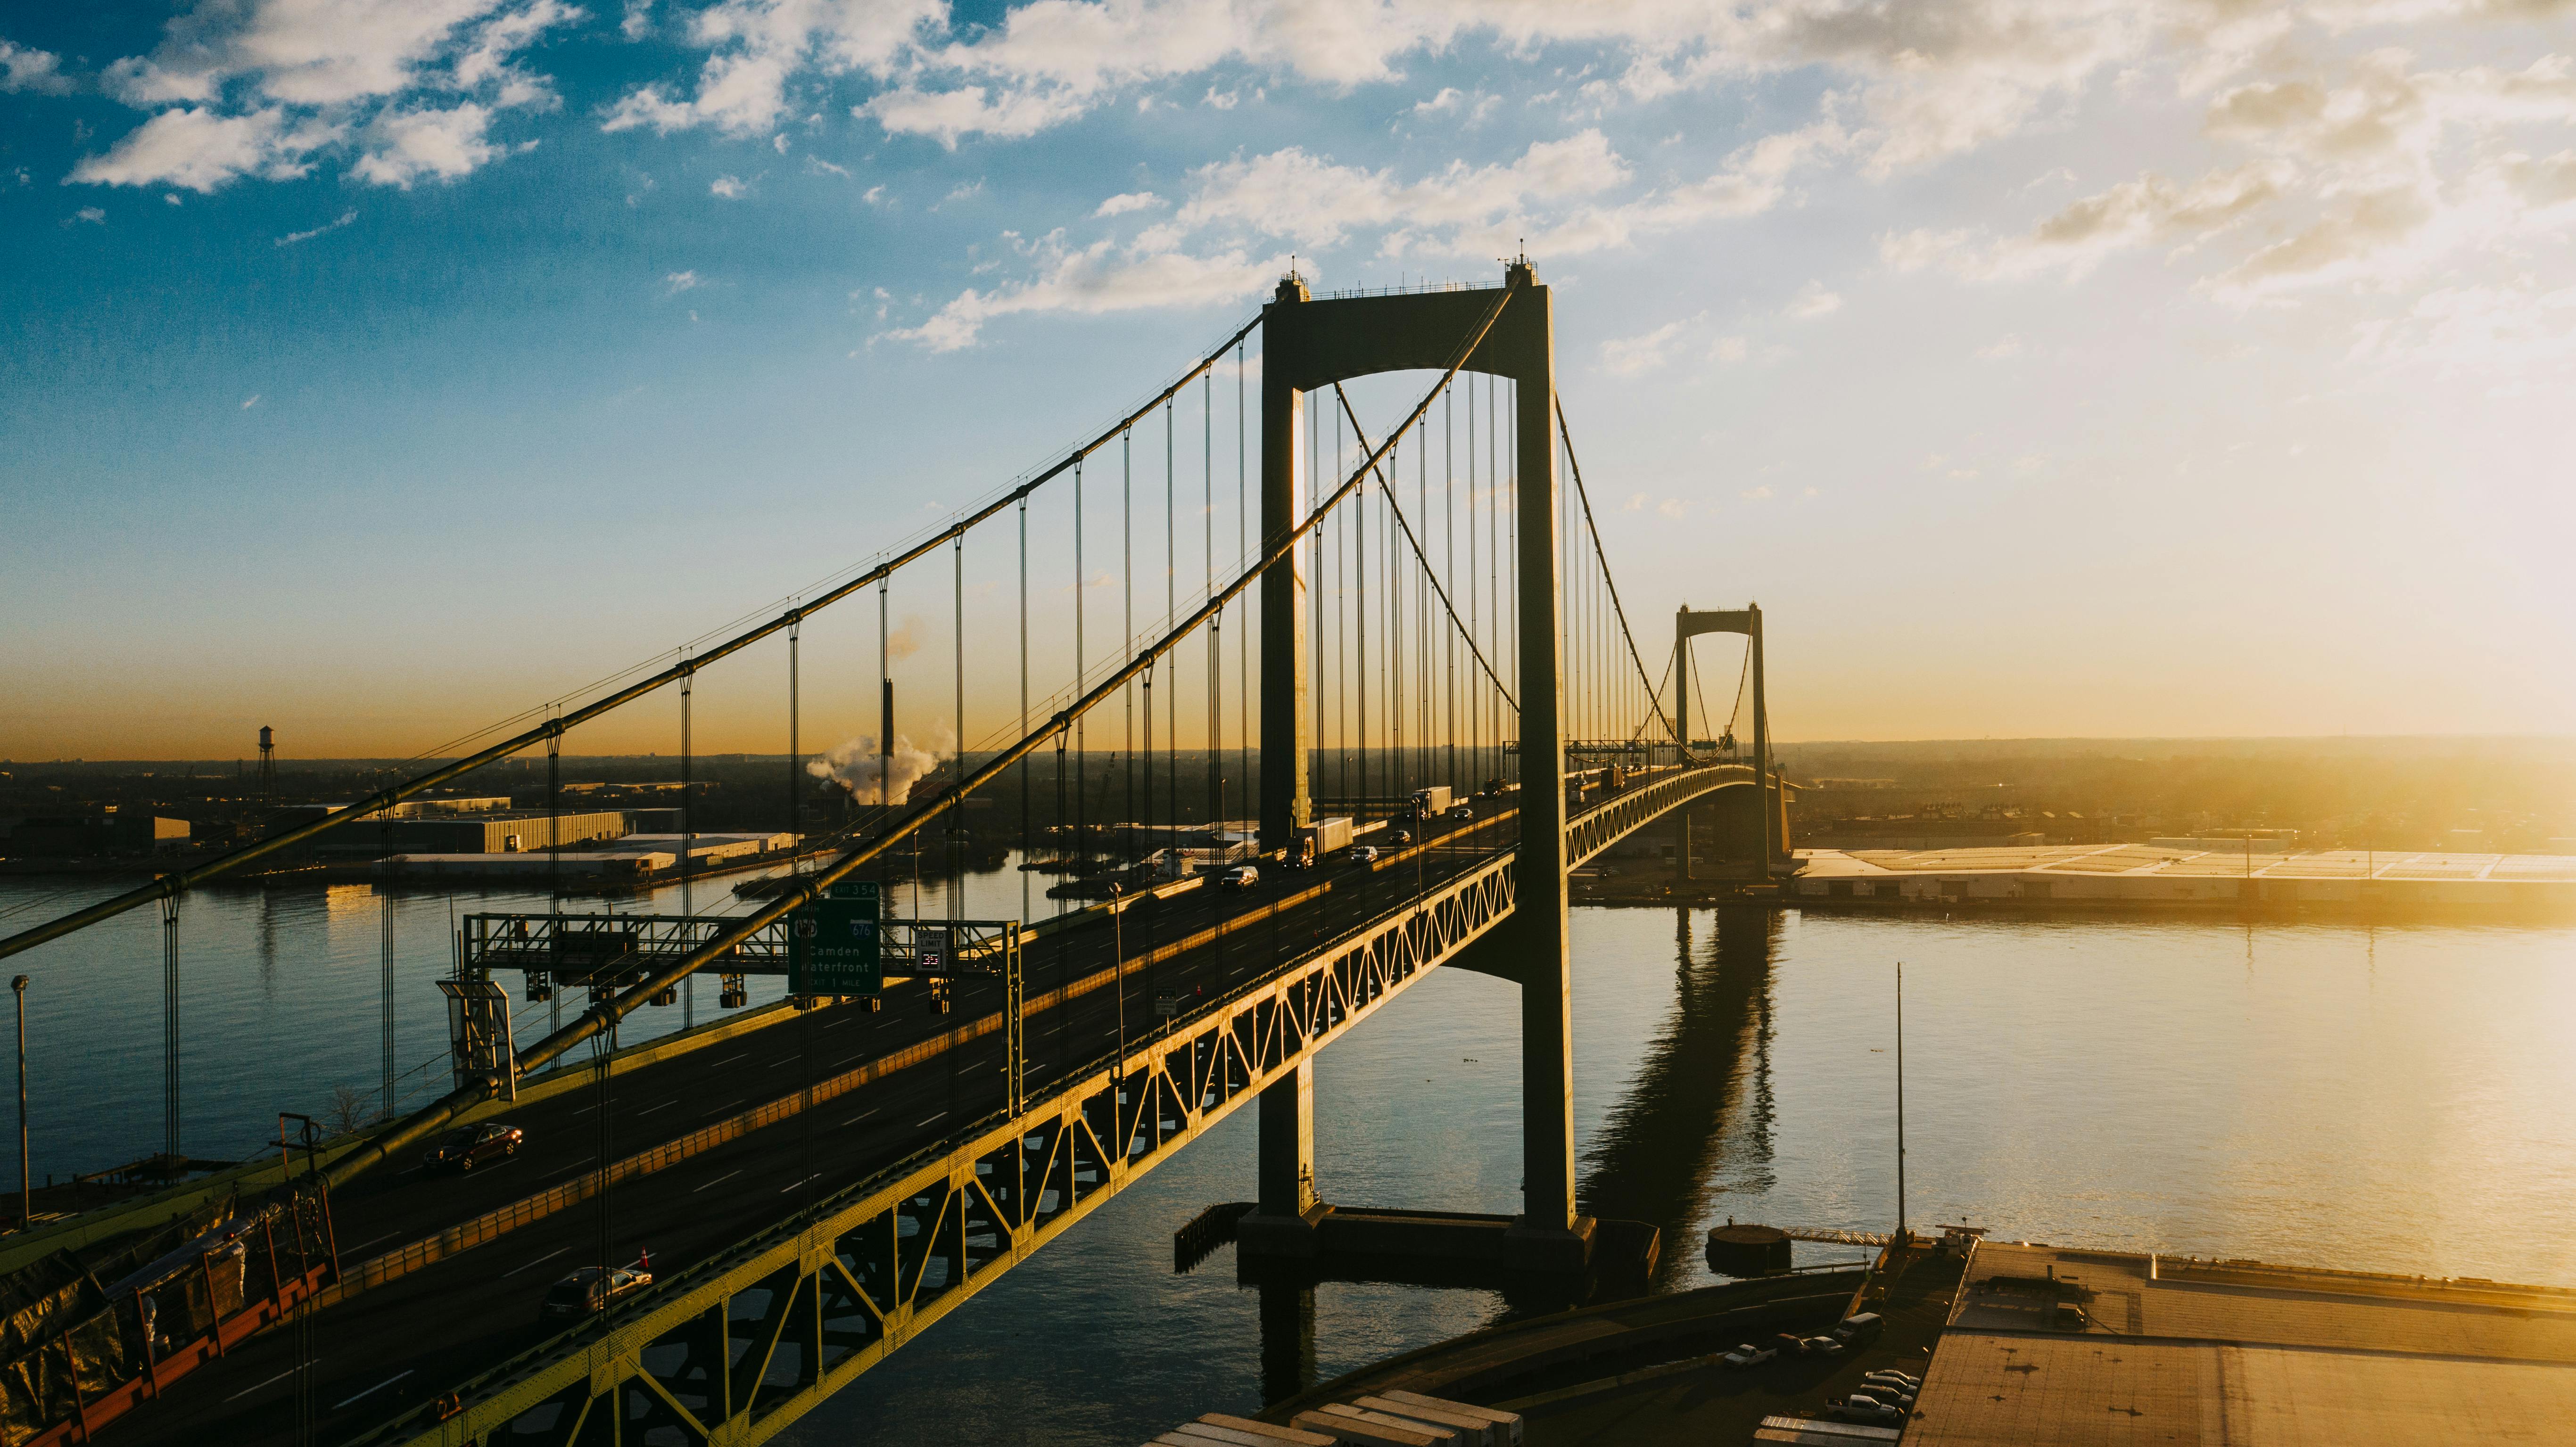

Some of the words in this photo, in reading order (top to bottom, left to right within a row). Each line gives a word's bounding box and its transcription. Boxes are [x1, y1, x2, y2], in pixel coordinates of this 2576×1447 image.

[852, 885, 875, 895] 354
[853, 924, 870, 936] 676
[810, 946, 859, 956] Camden
[923, 954, 938, 964] 35
[832, 978, 836, 987] 1
